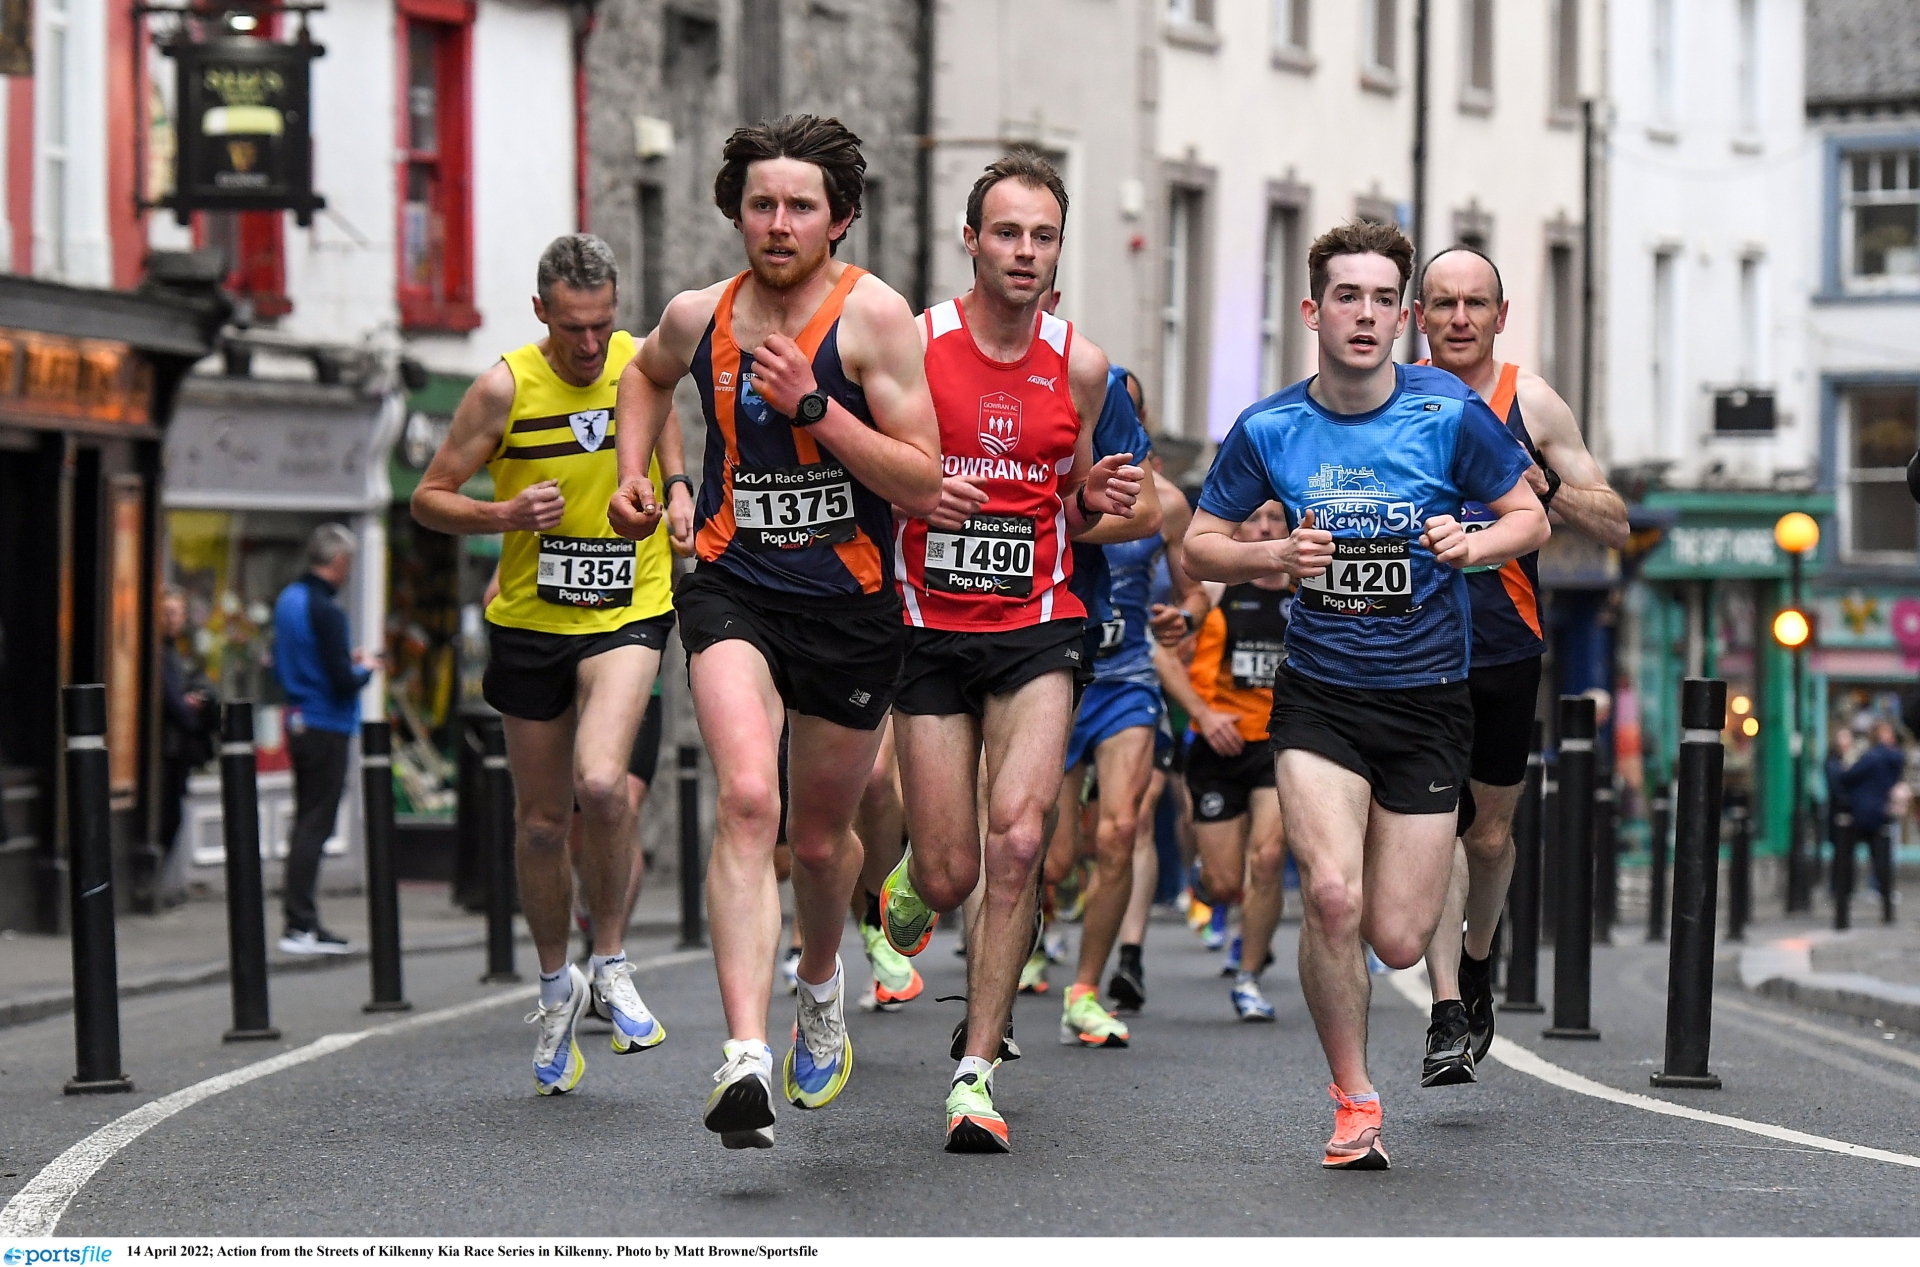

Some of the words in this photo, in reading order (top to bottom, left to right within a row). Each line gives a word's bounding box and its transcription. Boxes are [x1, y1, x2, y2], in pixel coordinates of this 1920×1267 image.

[983, 402, 1009, 411] GOWRAN
[775, 473, 805, 484] Race
[807, 468, 844, 482] Series
[941, 454, 1024, 481] OWRAN
[1027, 463, 1050, 483] AC
[755, 485, 849, 526] 1375
[1326, 503, 1379, 515] STREETS
[973, 520, 1000, 533] Race
[1002, 522, 1033, 535] Series
[580, 542, 604, 553] Race
[605, 542, 634, 553] Series
[760, 531, 788, 548] Pop
[788, 530, 809, 546] Up
[950, 537, 1032, 574] 1490
[1338, 544, 1367, 554] Race
[1369, 543, 1405, 554] Series
[560, 558, 632, 587] 1354
[1325, 562, 1407, 593] 1420
[948, 573, 974, 590] Pop
[974, 576, 993, 592] Up
[558, 589, 581, 604] Pop
[582, 591, 600, 605] Up
[1322, 594, 1347, 612] Pop
[1347, 597, 1367, 613] Up
